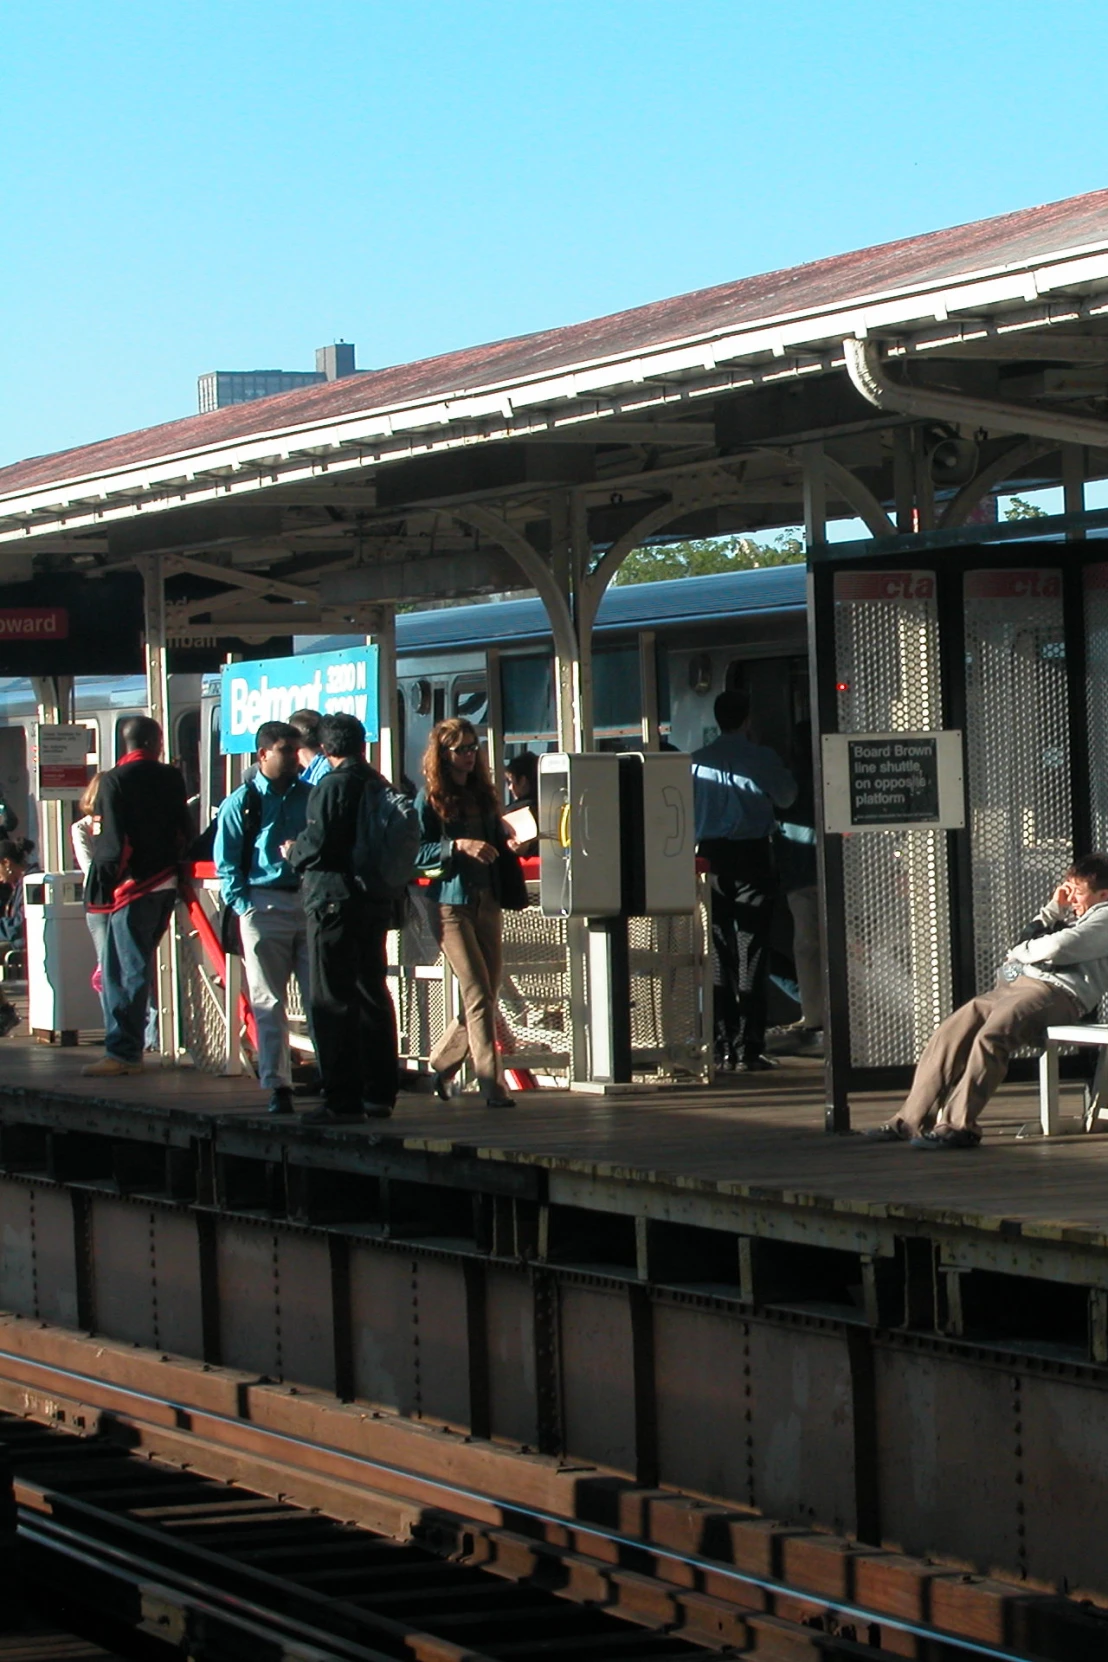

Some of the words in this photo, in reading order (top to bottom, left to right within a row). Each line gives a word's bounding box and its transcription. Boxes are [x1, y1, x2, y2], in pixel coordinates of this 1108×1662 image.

[881, 573, 934, 599] cta
[1010, 572, 1061, 598] cta
[325, 662, 356, 694] 3200
[356, 661, 367, 691] N
[231, 669, 322, 735] Belmont
[854, 745, 890, 758] Board
[894, 744, 932, 756] Brown
[854, 762, 877, 773] line
[880, 760, 921, 773] shuttle
[855, 780, 871, 789] on
[874, 776, 926, 791] opposite
[855, 792, 905, 807] platform
